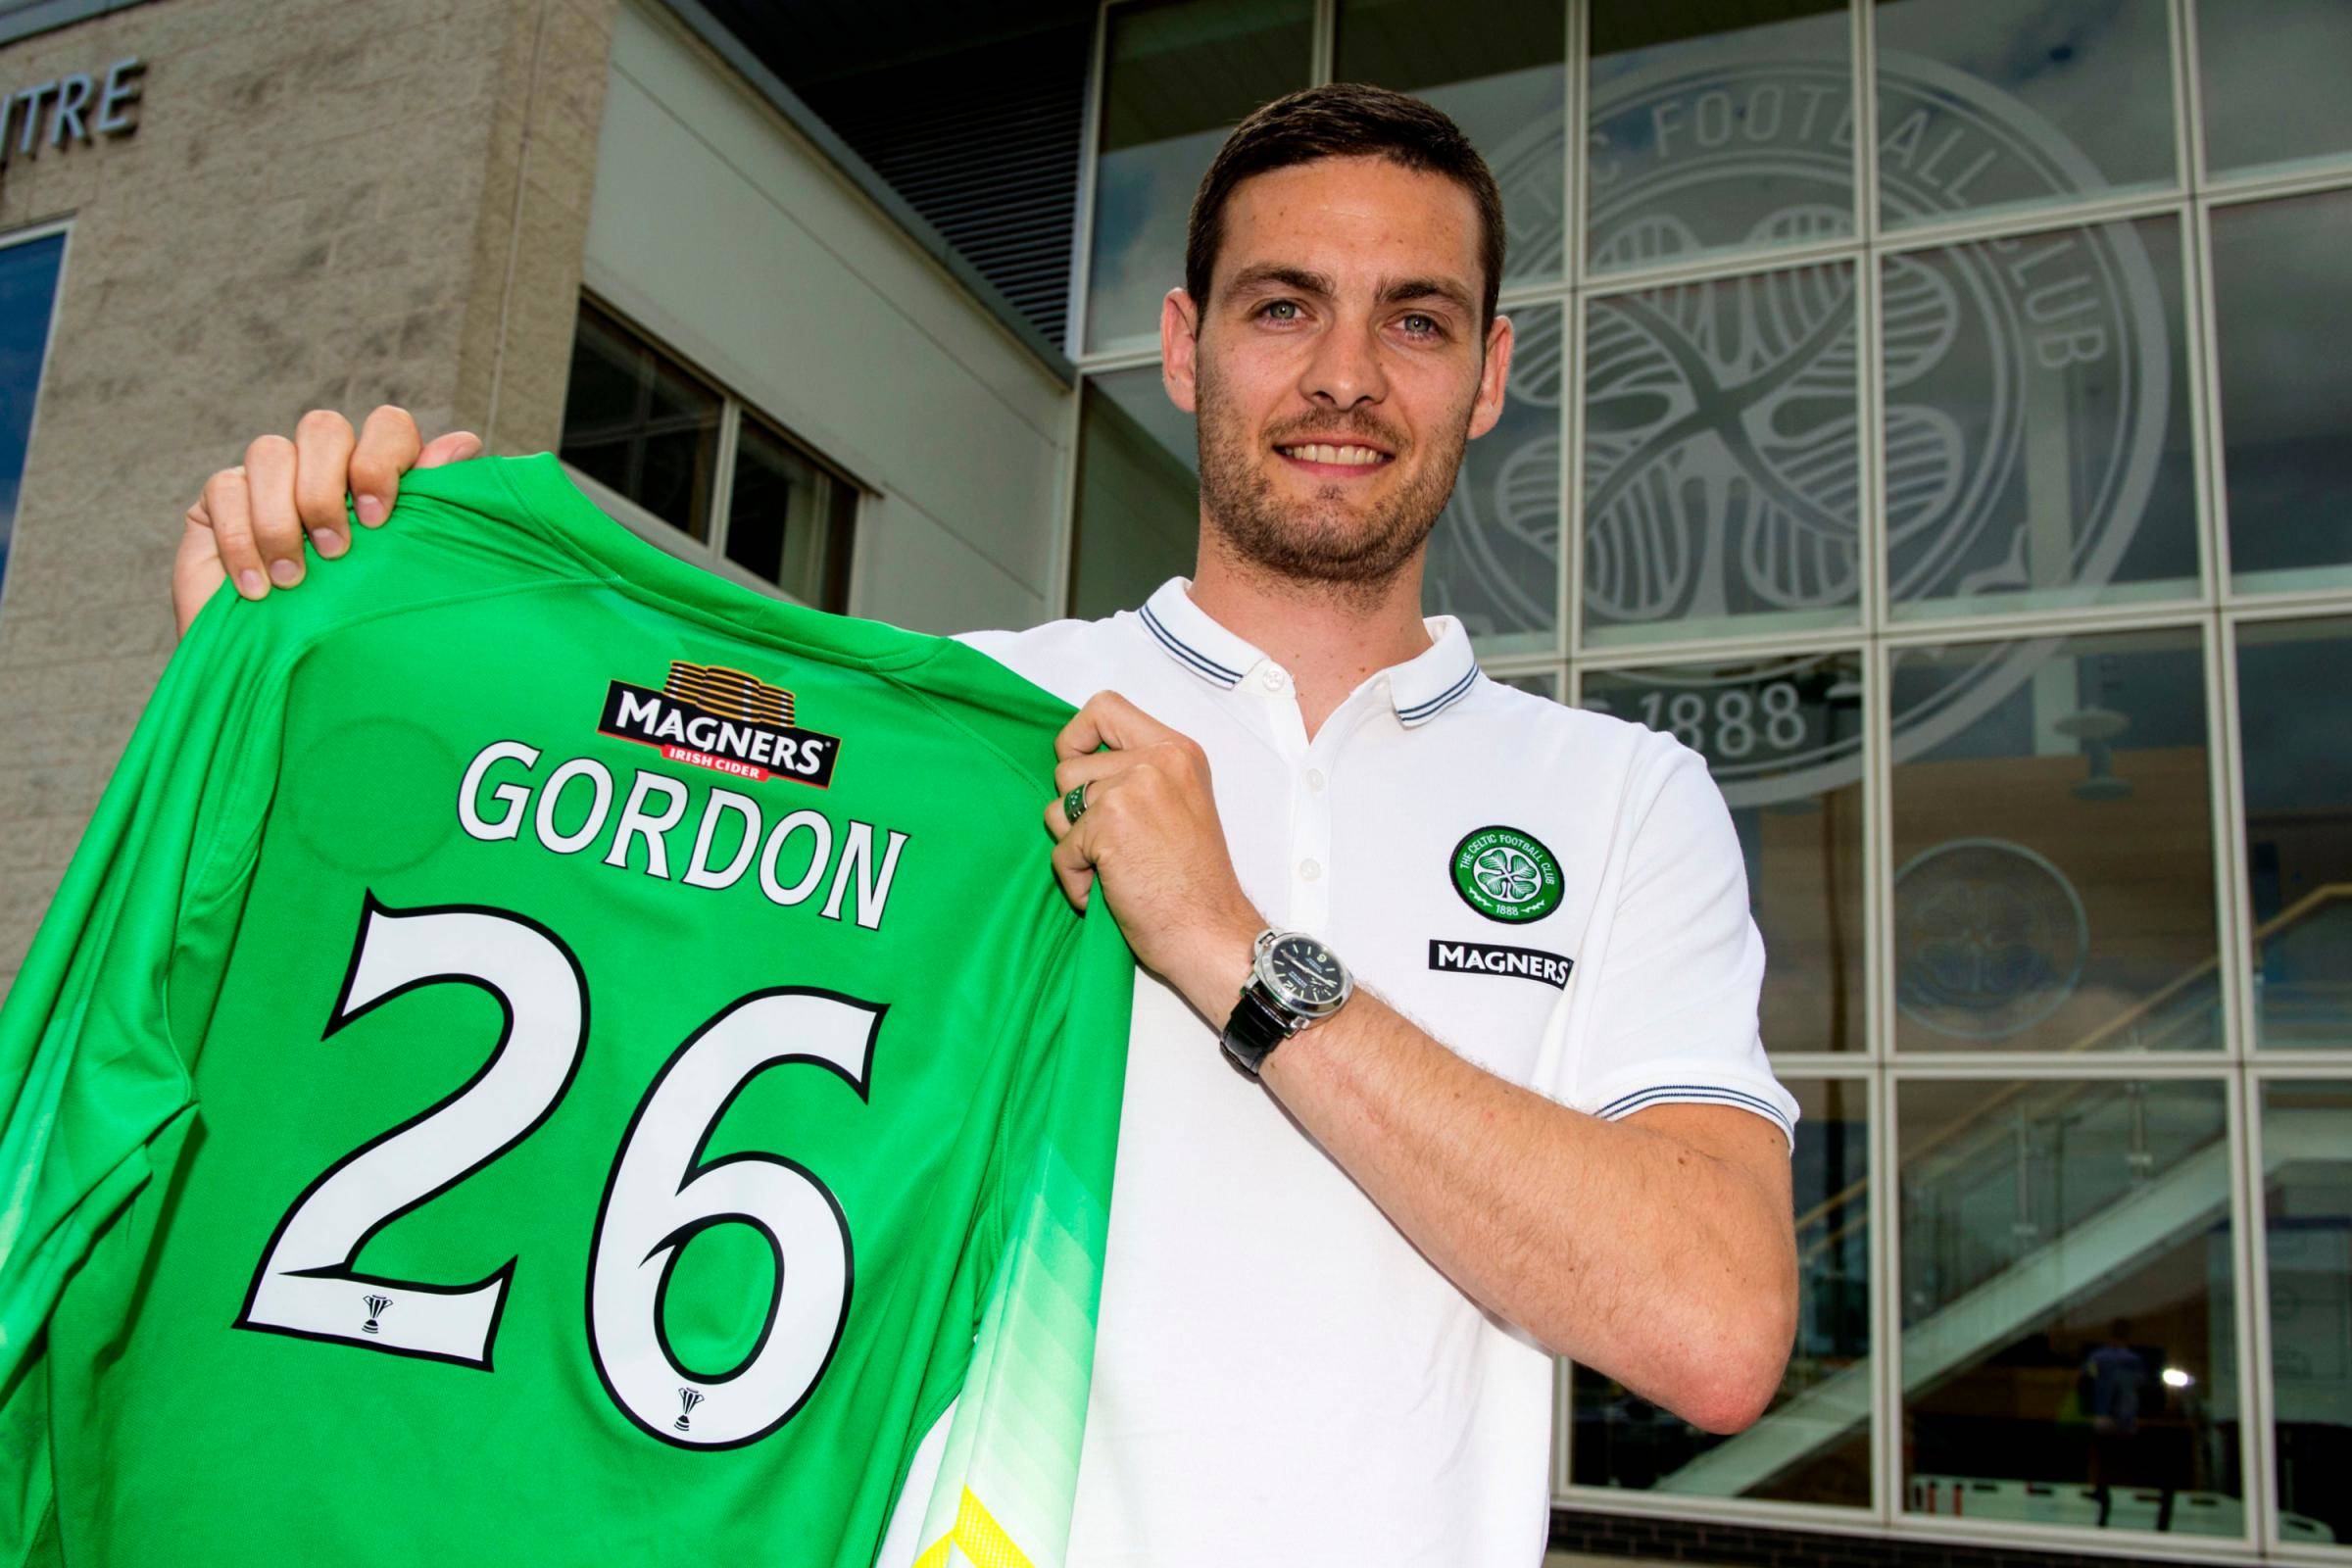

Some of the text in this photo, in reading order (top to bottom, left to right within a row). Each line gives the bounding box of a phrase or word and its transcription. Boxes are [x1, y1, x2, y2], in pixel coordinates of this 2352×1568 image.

[1992, 238, 2107, 369] LUB
[615, 690, 824, 775] MAGNERS
[1640, 682, 1806, 759] 1888
[669, 747, 760, 780] IRISH CIDER
[457, 738, 911, 932] GORDON
[1460, 834, 1555, 885] THE CELTIC FOOTBALL CLUB
[1495, 904, 1519, 916] 1888
[1438, 943, 1569, 985] MAGNERS
[230, 886, 892, 1453] 26
